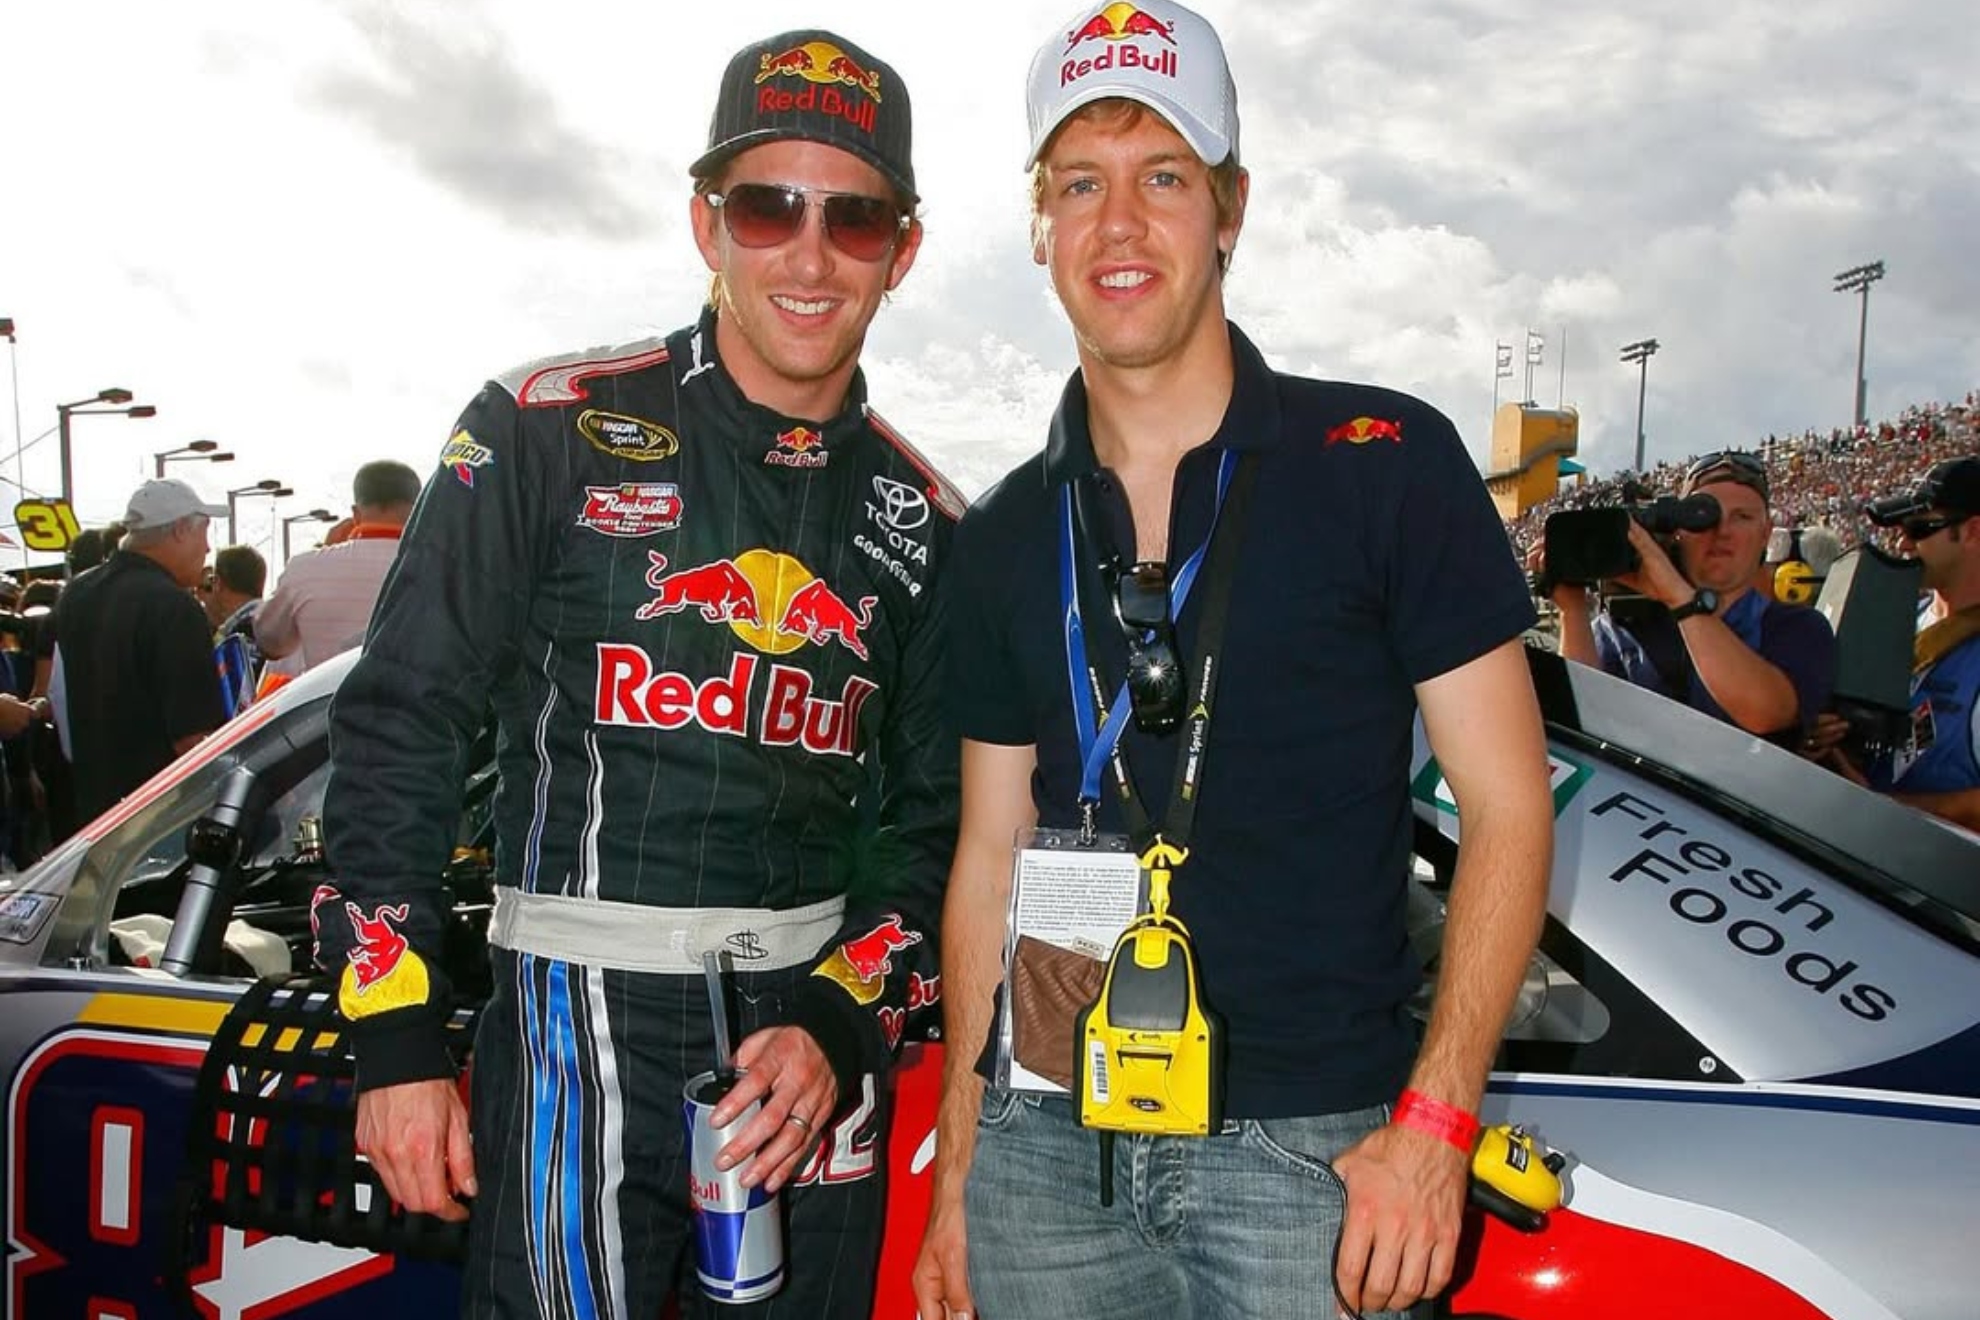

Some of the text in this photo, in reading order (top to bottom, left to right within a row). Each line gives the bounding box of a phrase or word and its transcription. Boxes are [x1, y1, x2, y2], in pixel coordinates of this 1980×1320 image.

[1061, 44, 1177, 88] Red Bull
[758, 83, 877, 133] Red Bull
[610, 432, 645, 446] Sprint
[764, 450, 829, 467] Red Bull
[17, 504, 80, 550] 31
[594, 643, 879, 757] Red Bull
[1590, 791, 1835, 933] Fresh
[1609, 849, 1897, 1021] Foods
